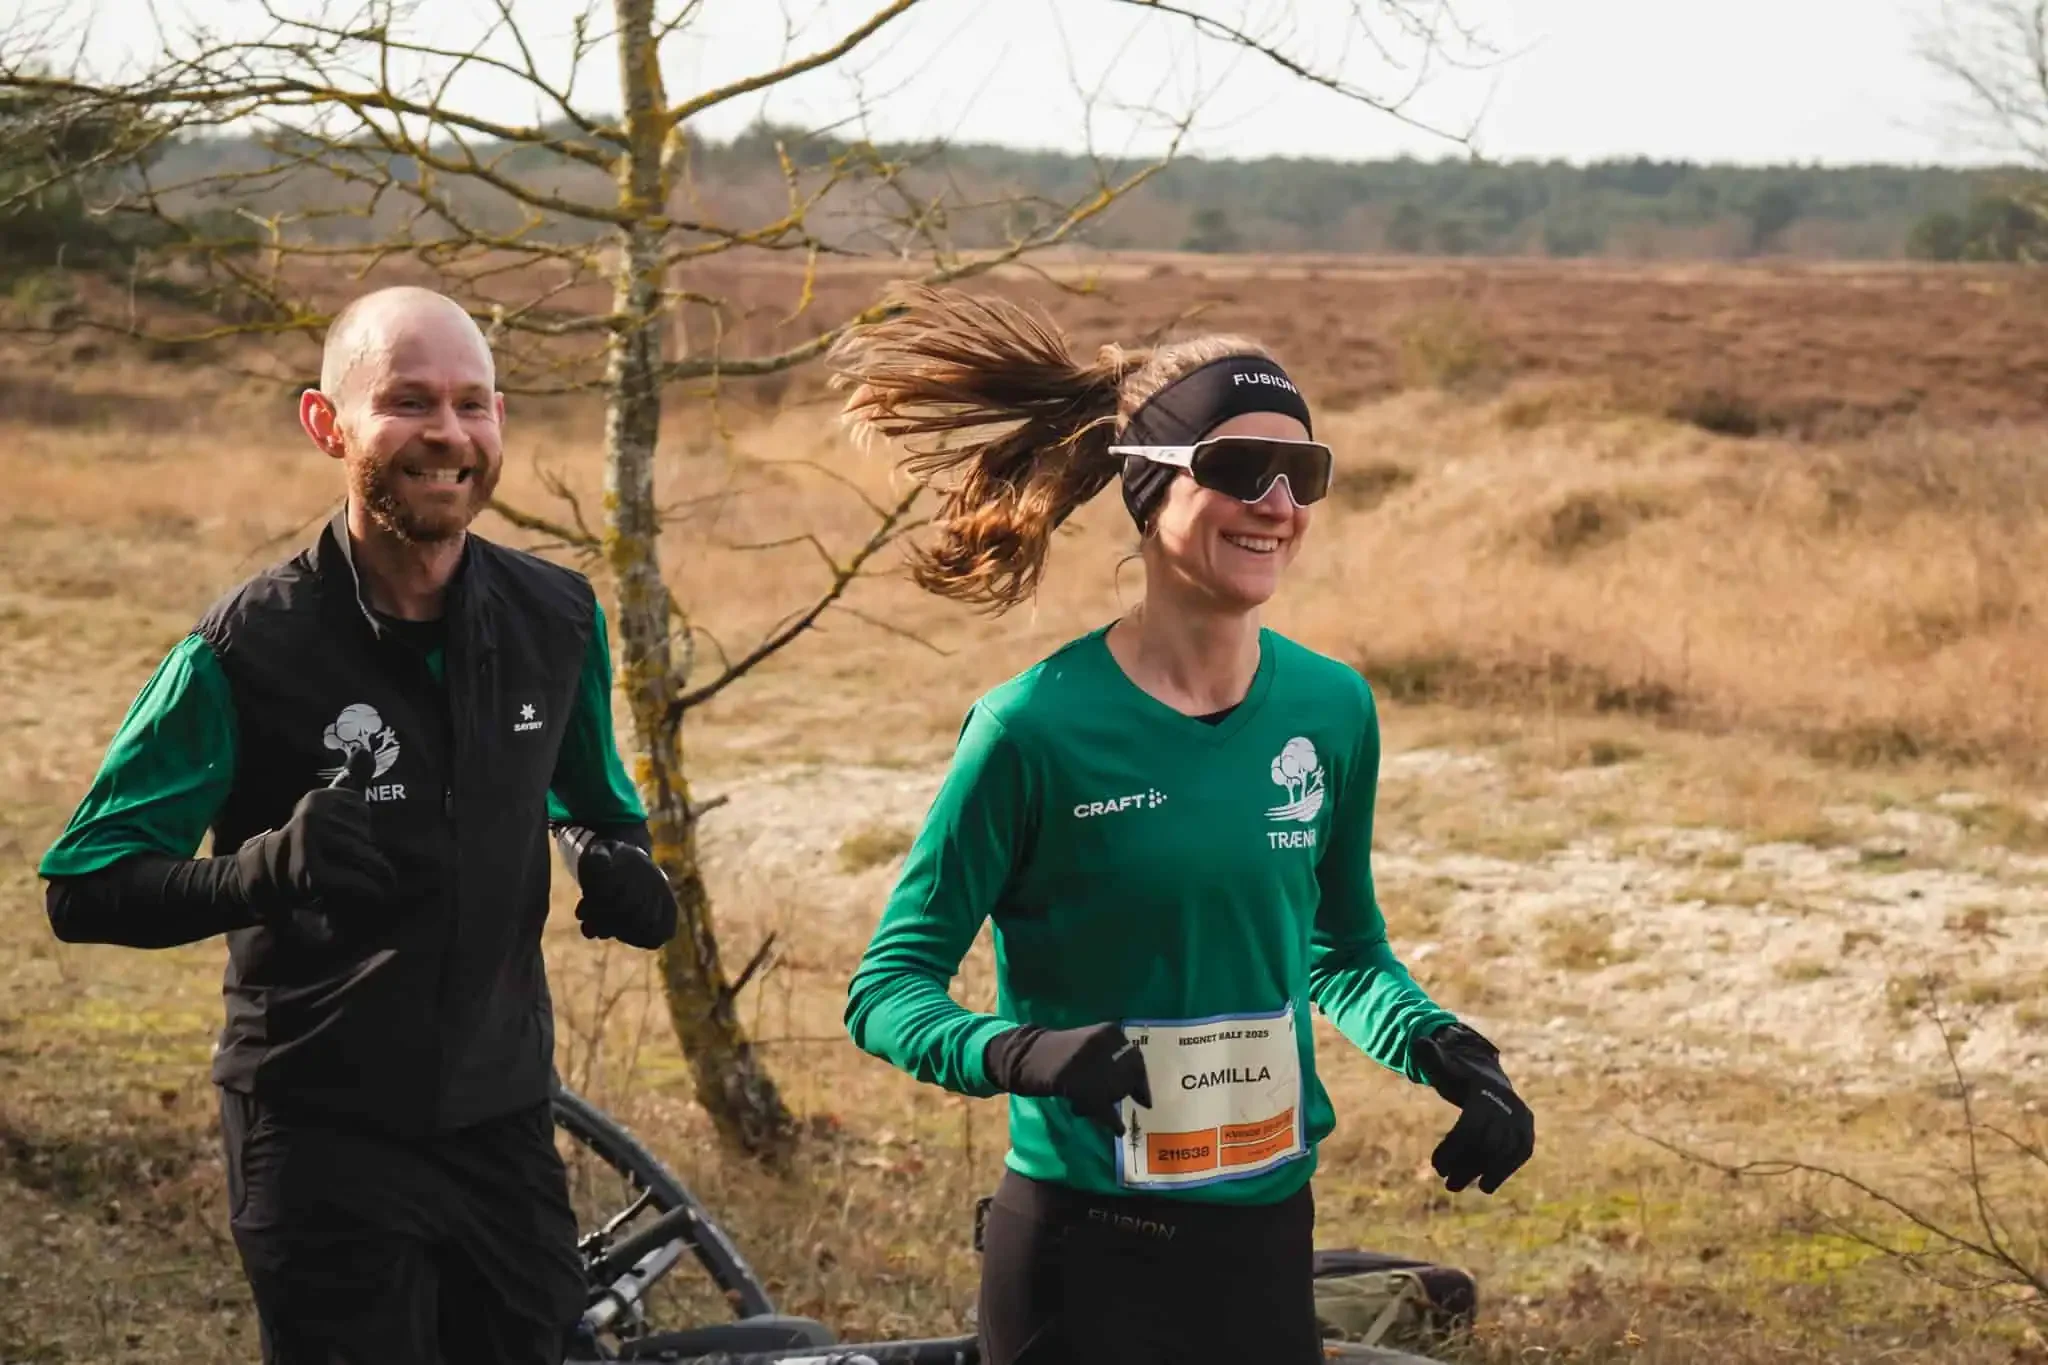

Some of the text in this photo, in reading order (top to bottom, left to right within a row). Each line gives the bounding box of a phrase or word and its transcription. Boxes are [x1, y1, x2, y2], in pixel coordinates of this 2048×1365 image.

[1233, 373, 1297, 394] FUSION
[365, 784, 406, 801] NER
[1074, 794, 1145, 818] CRAFT
[1266, 829, 1316, 849] TRÆN
[1245, 1030, 1270, 1039] 2025
[1181, 1066, 1271, 1090] CAMILLA
